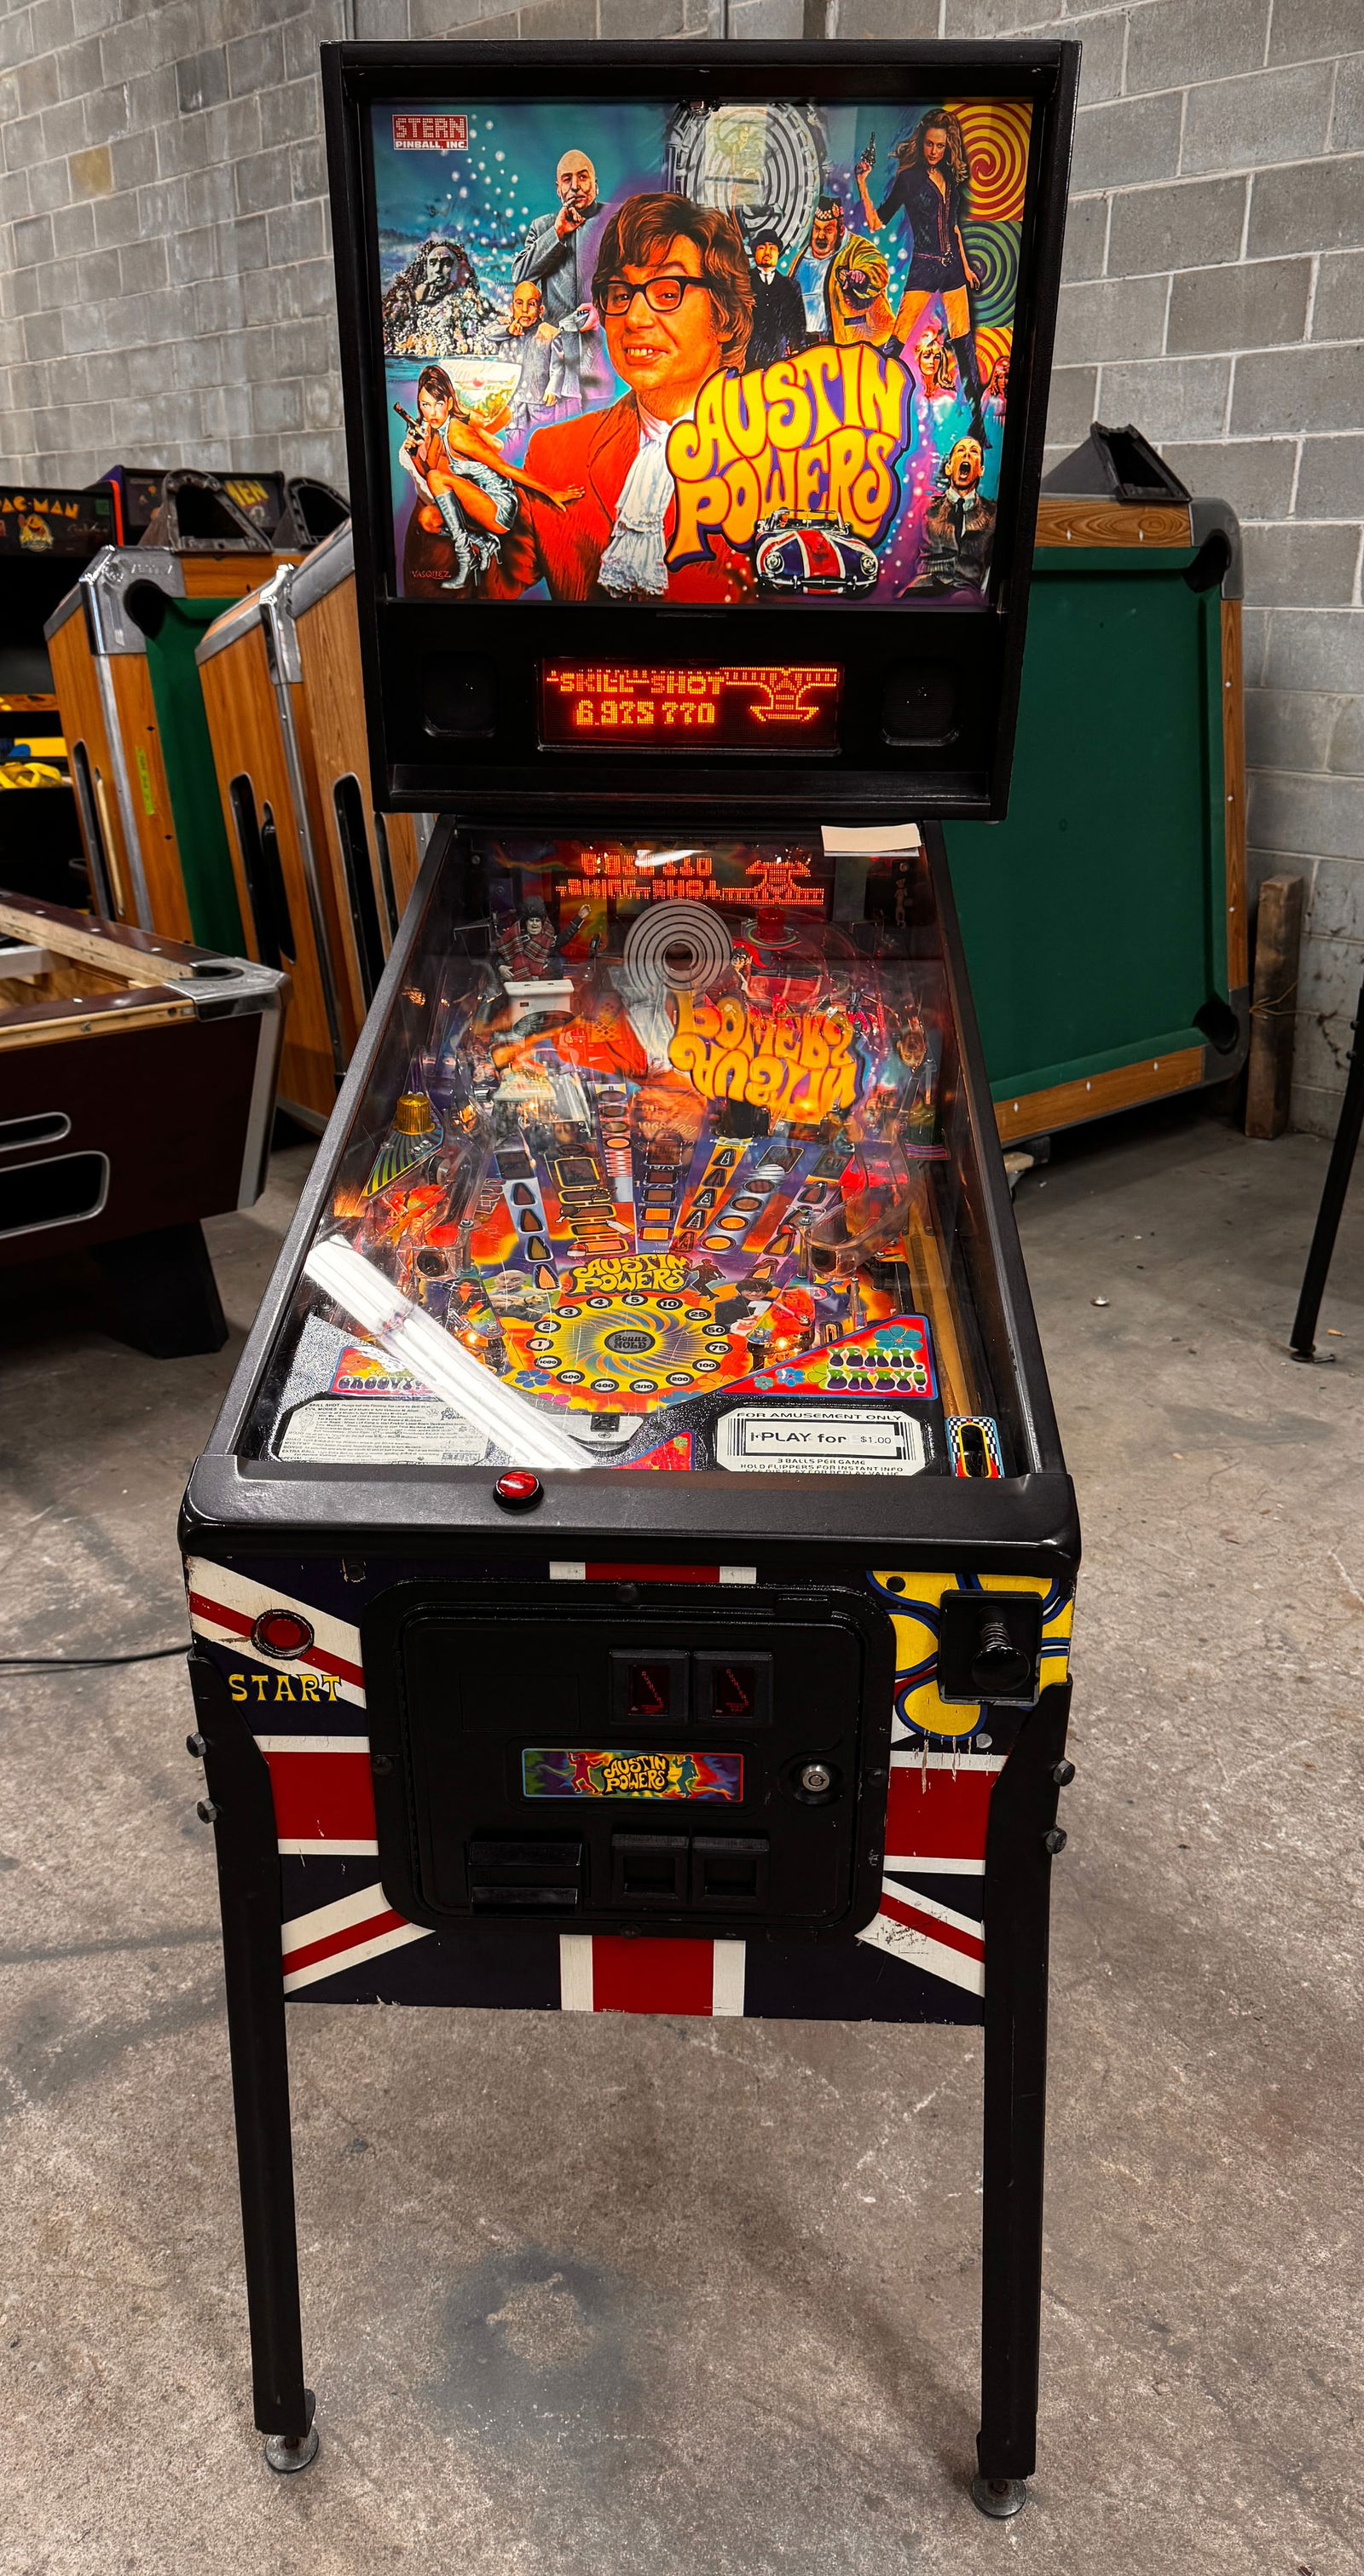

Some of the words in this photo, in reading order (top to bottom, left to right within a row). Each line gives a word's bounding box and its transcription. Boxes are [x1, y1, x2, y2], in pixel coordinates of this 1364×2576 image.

[396, 118, 465, 138] STERN
[396, 141, 444, 149] PINBALL,
[668, 343, 908, 482] AUSTIN
[0, 495, 79, 519] AC-MAN
[667, 428, 897, 563] POWERS
[412, 570, 452, 579] VASQUEZ
[559, 672, 634, 692] SKILL
[651, 673, 724, 695] SHOT
[572, 1253, 687, 1278] AUSTIN
[569, 1269, 685, 1294] POWERS
[827, 1347, 924, 1371] YEAH,
[827, 1369, 928, 1392] BABY!
[817, 1434, 847, 1443] for
[860, 1435, 892, 1444] $1.00
[228, 1673, 343, 1702] START
[603, 1754, 668, 1778] AUSTIN
[602, 1770, 668, 1793] POWERS
